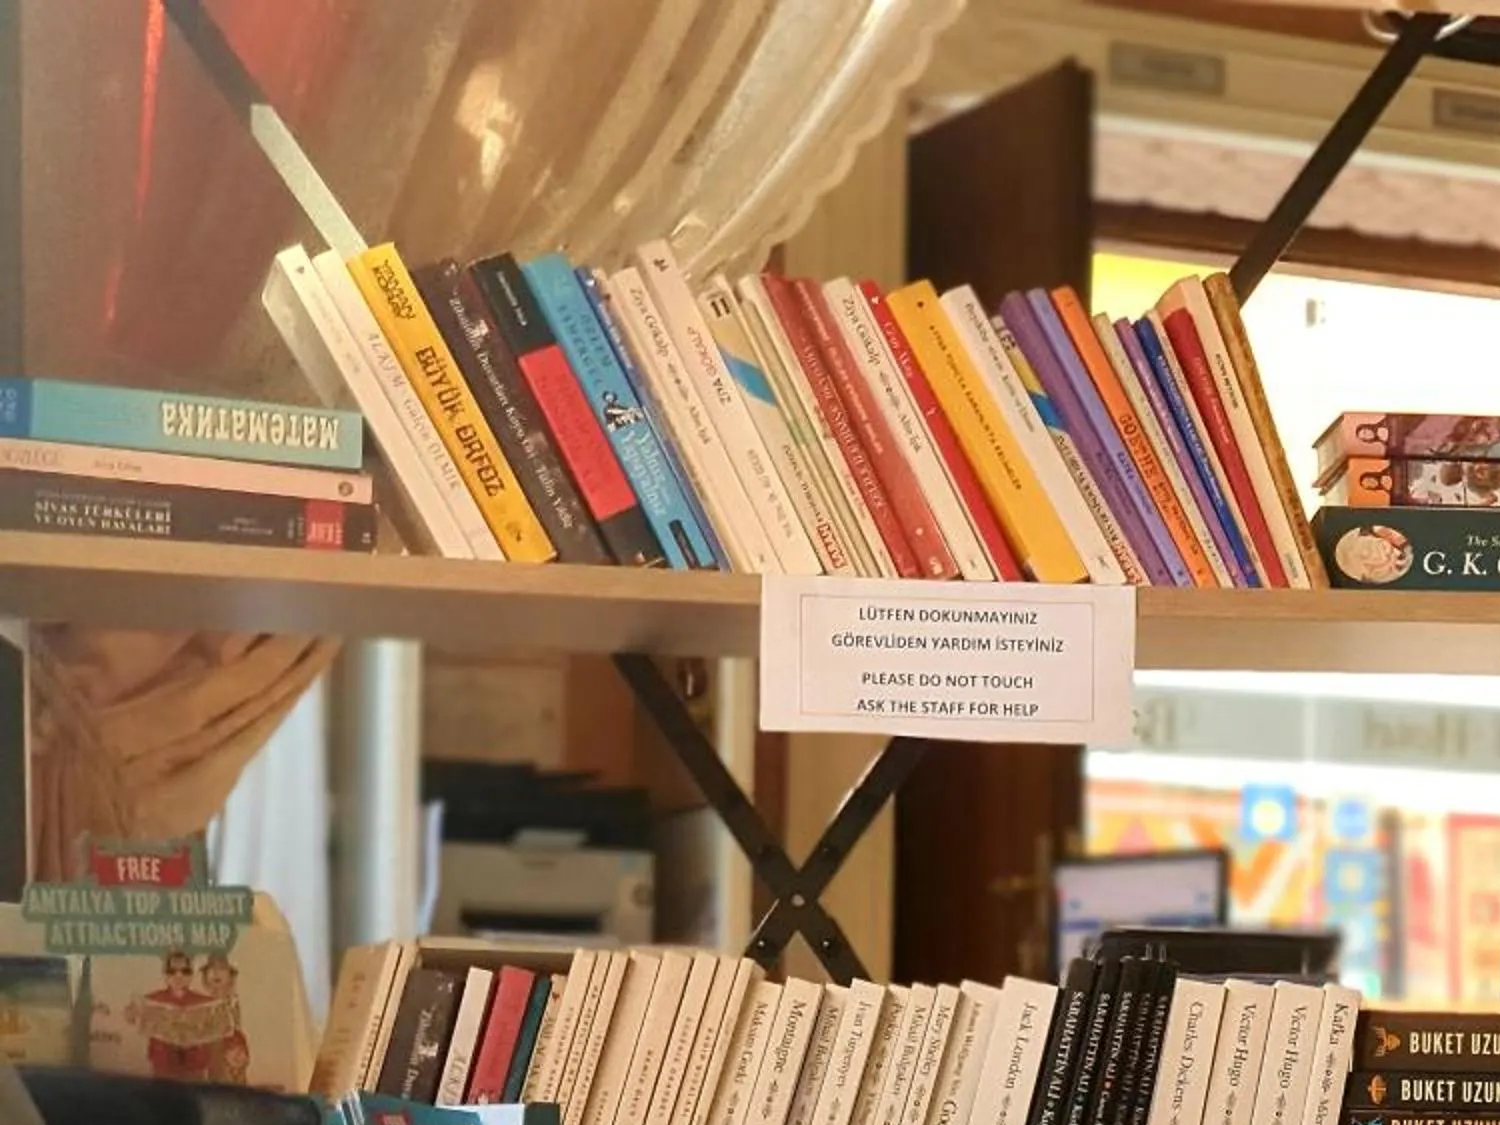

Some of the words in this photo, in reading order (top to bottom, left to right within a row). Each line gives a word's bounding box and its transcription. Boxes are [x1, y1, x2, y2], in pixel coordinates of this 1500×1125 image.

[629, 288, 648, 314] Ziya
[644, 314, 668, 356] Gökalp
[841, 296, 859, 324] Ziya
[855, 323, 880, 365] Gökalp
[415, 347, 461, 419] BÜYÜK
[455, 424, 504, 496] ORFOZ
[1467, 535, 1488, 547] The
[1423, 551, 1452, 575] G.
[1463, 552, 1487, 576] K.
[859, 605, 914, 621] LÜTFEN
[919, 608, 1037, 625] DOKUNMAYINIZ
[831, 633, 927, 649] GÖREVLİDEN
[932, 637, 990, 651] YARDIM
[995, 637, 1063, 653] İSTEYİNİZ
[862, 672, 914, 687] PLEASE
[919, 674, 941, 688] DO
[946, 675, 977, 689] NOT
[983, 675, 1033, 689] TOUCH
[857, 699, 885, 712] ASK
[890, 700, 917, 714] THE
[921, 701, 965, 715] STAFF
[970, 702, 998, 715] FOR
[1003, 703, 1038, 717] HELP
[117, 856, 162, 882] FREE
[28, 888, 115, 915] ANTALYA
[126, 889, 161, 915] TOP
[172, 891, 246, 916] TOURIST
[51, 921, 184, 946] ATTRACTIONS
[192, 924, 231, 946] MAP
[746, 1003, 768, 1048] Maksim
[1019, 1002, 1037, 1030] Jack
[1183, 1001, 1203, 1049] Charles
[1237, 1003, 1257, 1044] Victor
[1287, 1006, 1307, 1046] Victor
[1329, 1003, 1348, 1045] Kafka
[773, 1000, 806, 1073] Montaigne
[1410, 1032, 1464, 1055] BUKET
[1004, 1036, 1029, 1089] London
[1172, 1055, 1194, 1109] Dickens
[1227, 1047, 1248, 1087] Hugo
[1277, 1049, 1299, 1089] Hugo
[1401, 1079, 1455, 1101] BUKET
